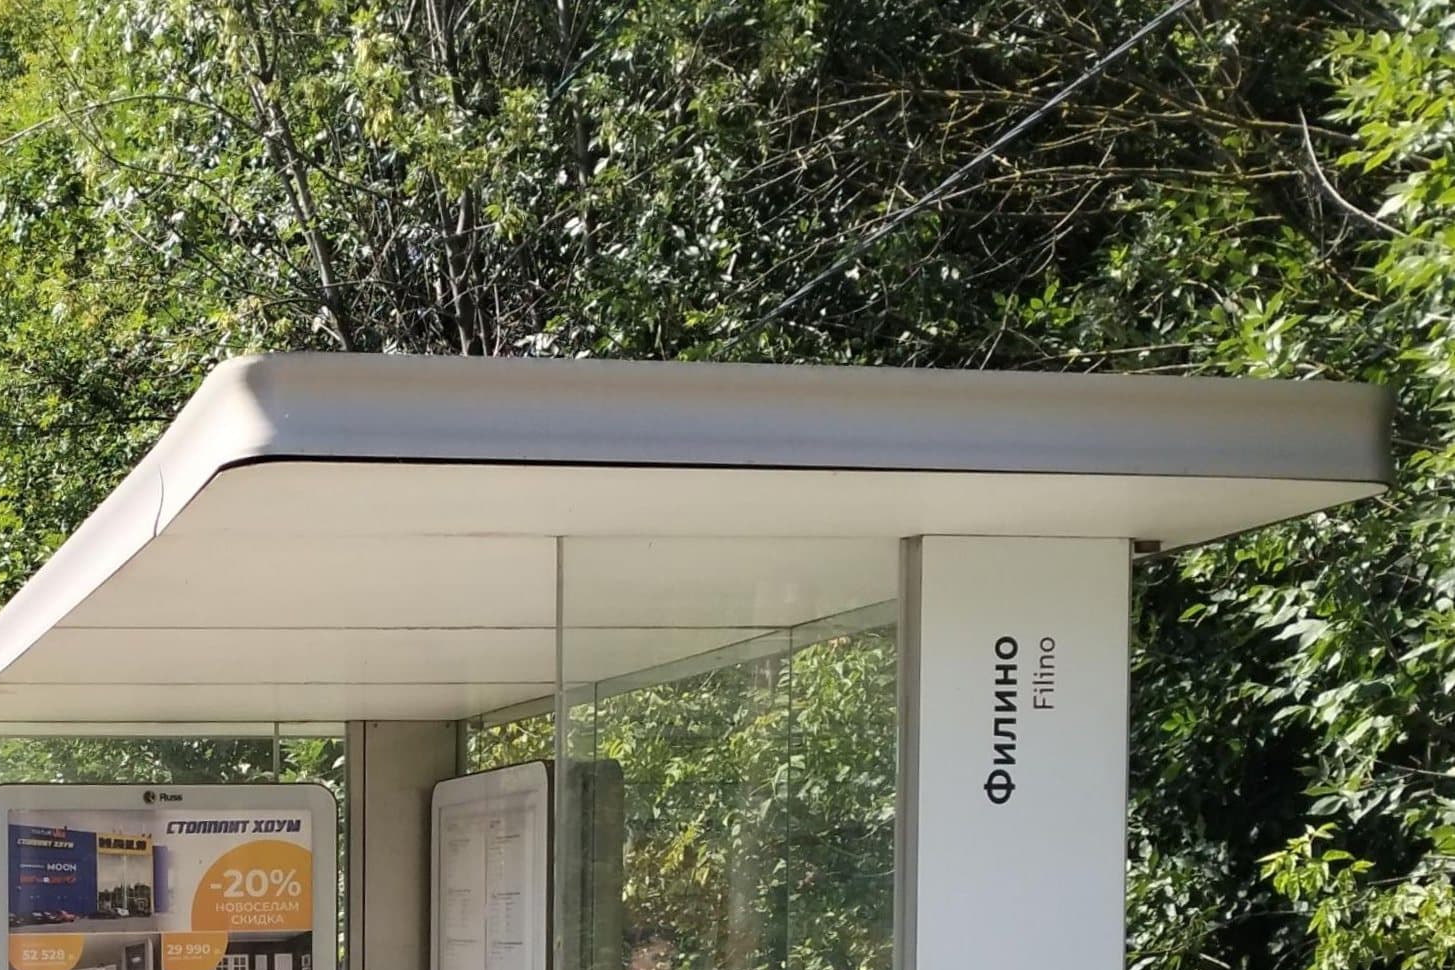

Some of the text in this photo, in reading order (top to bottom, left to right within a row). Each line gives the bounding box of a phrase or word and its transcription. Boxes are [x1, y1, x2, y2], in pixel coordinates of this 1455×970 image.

[1032, 636, 1056, 709] Filino
[983, 636, 1019, 805] Филино
[159, 793, 183, 801] Russ
[252, 819, 301, 833] ХОУМ
[47, 863, 77, 872] MOON
[209, 869, 302, 898] -20%
[215, 901, 300, 913] НОВОСЕЛАМ
[231, 914, 285, 926] СКИДКА
